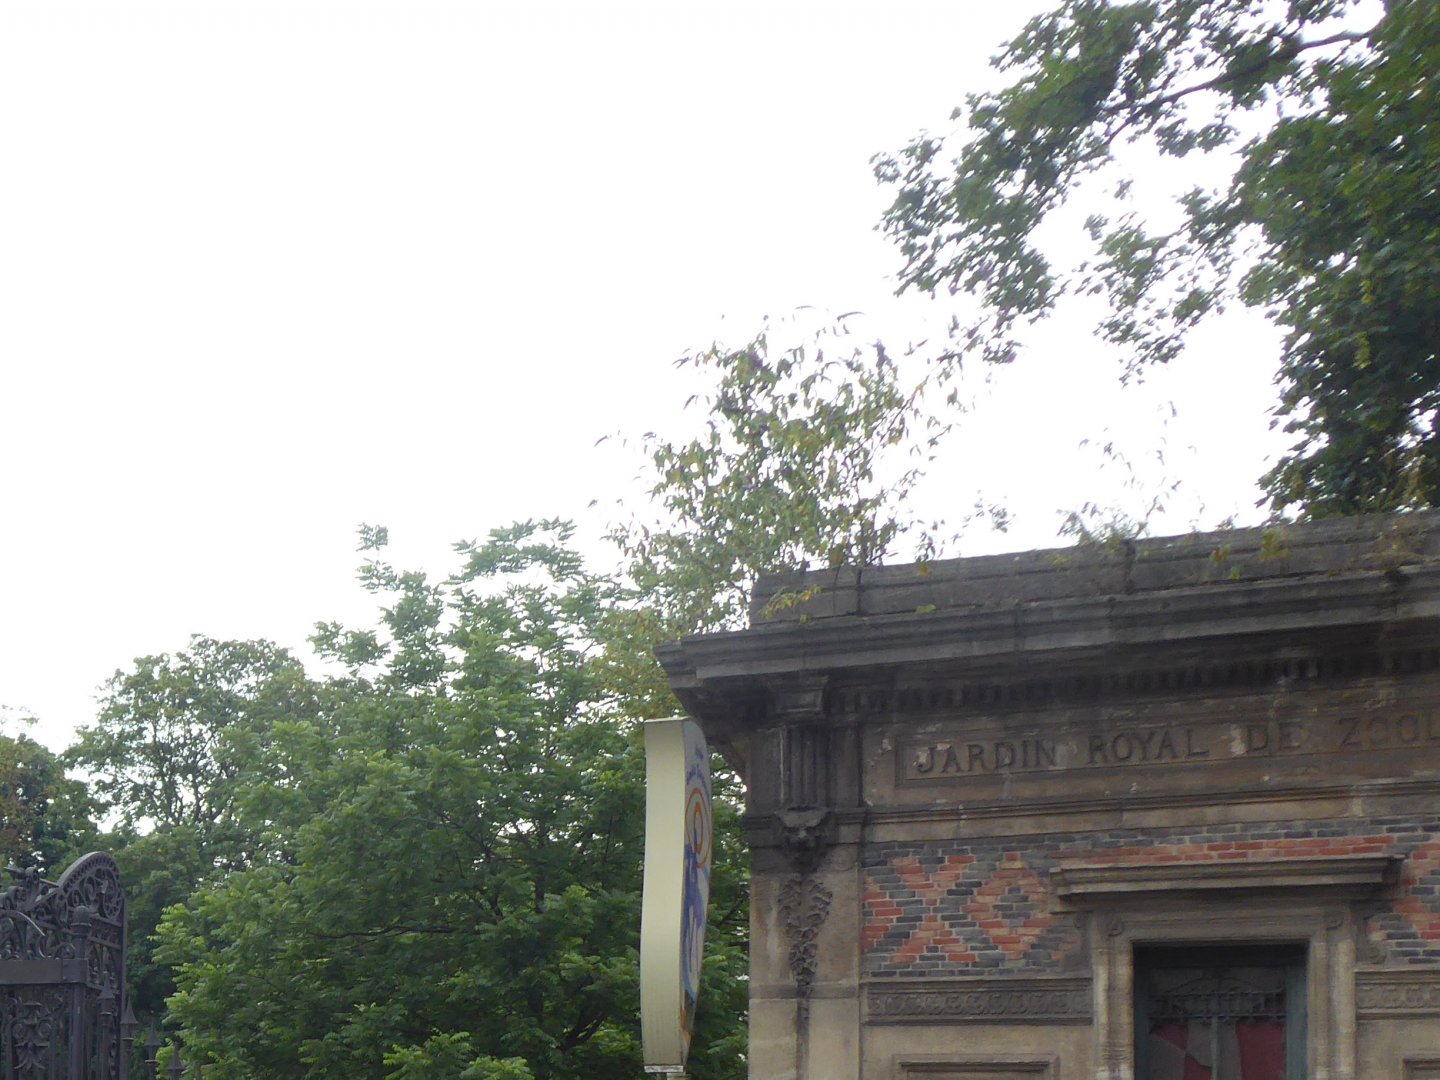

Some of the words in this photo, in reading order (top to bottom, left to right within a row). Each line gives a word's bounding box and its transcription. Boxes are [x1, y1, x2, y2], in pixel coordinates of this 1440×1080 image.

[914, 739, 1058, 774] JARDIN
[1087, 727, 1210, 765] ROYAL
[1247, 721, 1304, 751] DE
